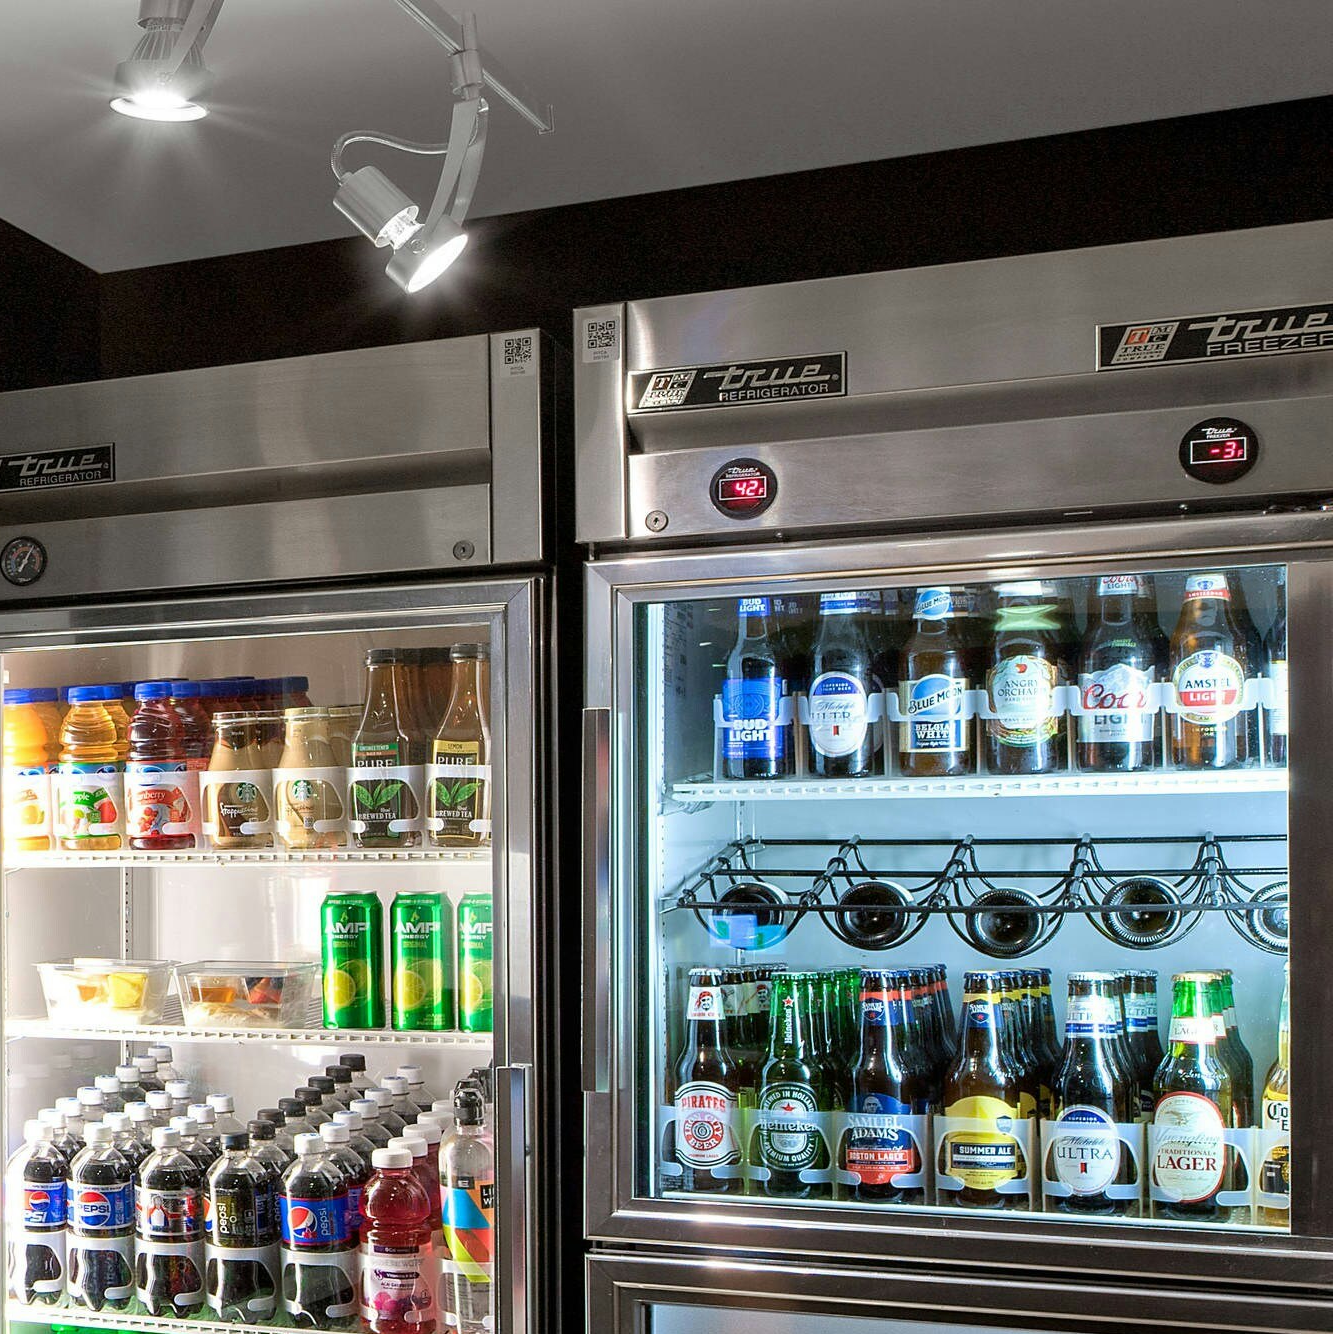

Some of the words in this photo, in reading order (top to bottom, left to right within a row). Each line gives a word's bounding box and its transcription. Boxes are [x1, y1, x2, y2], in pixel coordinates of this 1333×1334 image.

[1121, 343, 1165, 352] TRUE
[718, 384, 829, 402] REFRIGERATOR
[19, 470, 102, 487] REFRIGERATOR
[735, 480, 758, 496] 42
[908, 697, 935, 715] BLUE
[729, 729, 774, 742] LIGHT
[383, 811, 397, 820] TEA
[460, 810, 472, 819] TEA
[784, 1006, 793, 1046] Heineken
[681, 1094, 726, 1110] PIRATES
[851, 1127, 899, 1142] ADAMS
[959, 1145, 996, 1156] SUMMER
[1057, 1146, 1114, 1160] ULTRA
[1160, 1148, 1213, 1157] TRADITIONAL
[1157, 1154, 1217, 1171] LAGER
[219, 1203, 229, 1234] pepsi
[320, 1207, 331, 1236] pepsi
